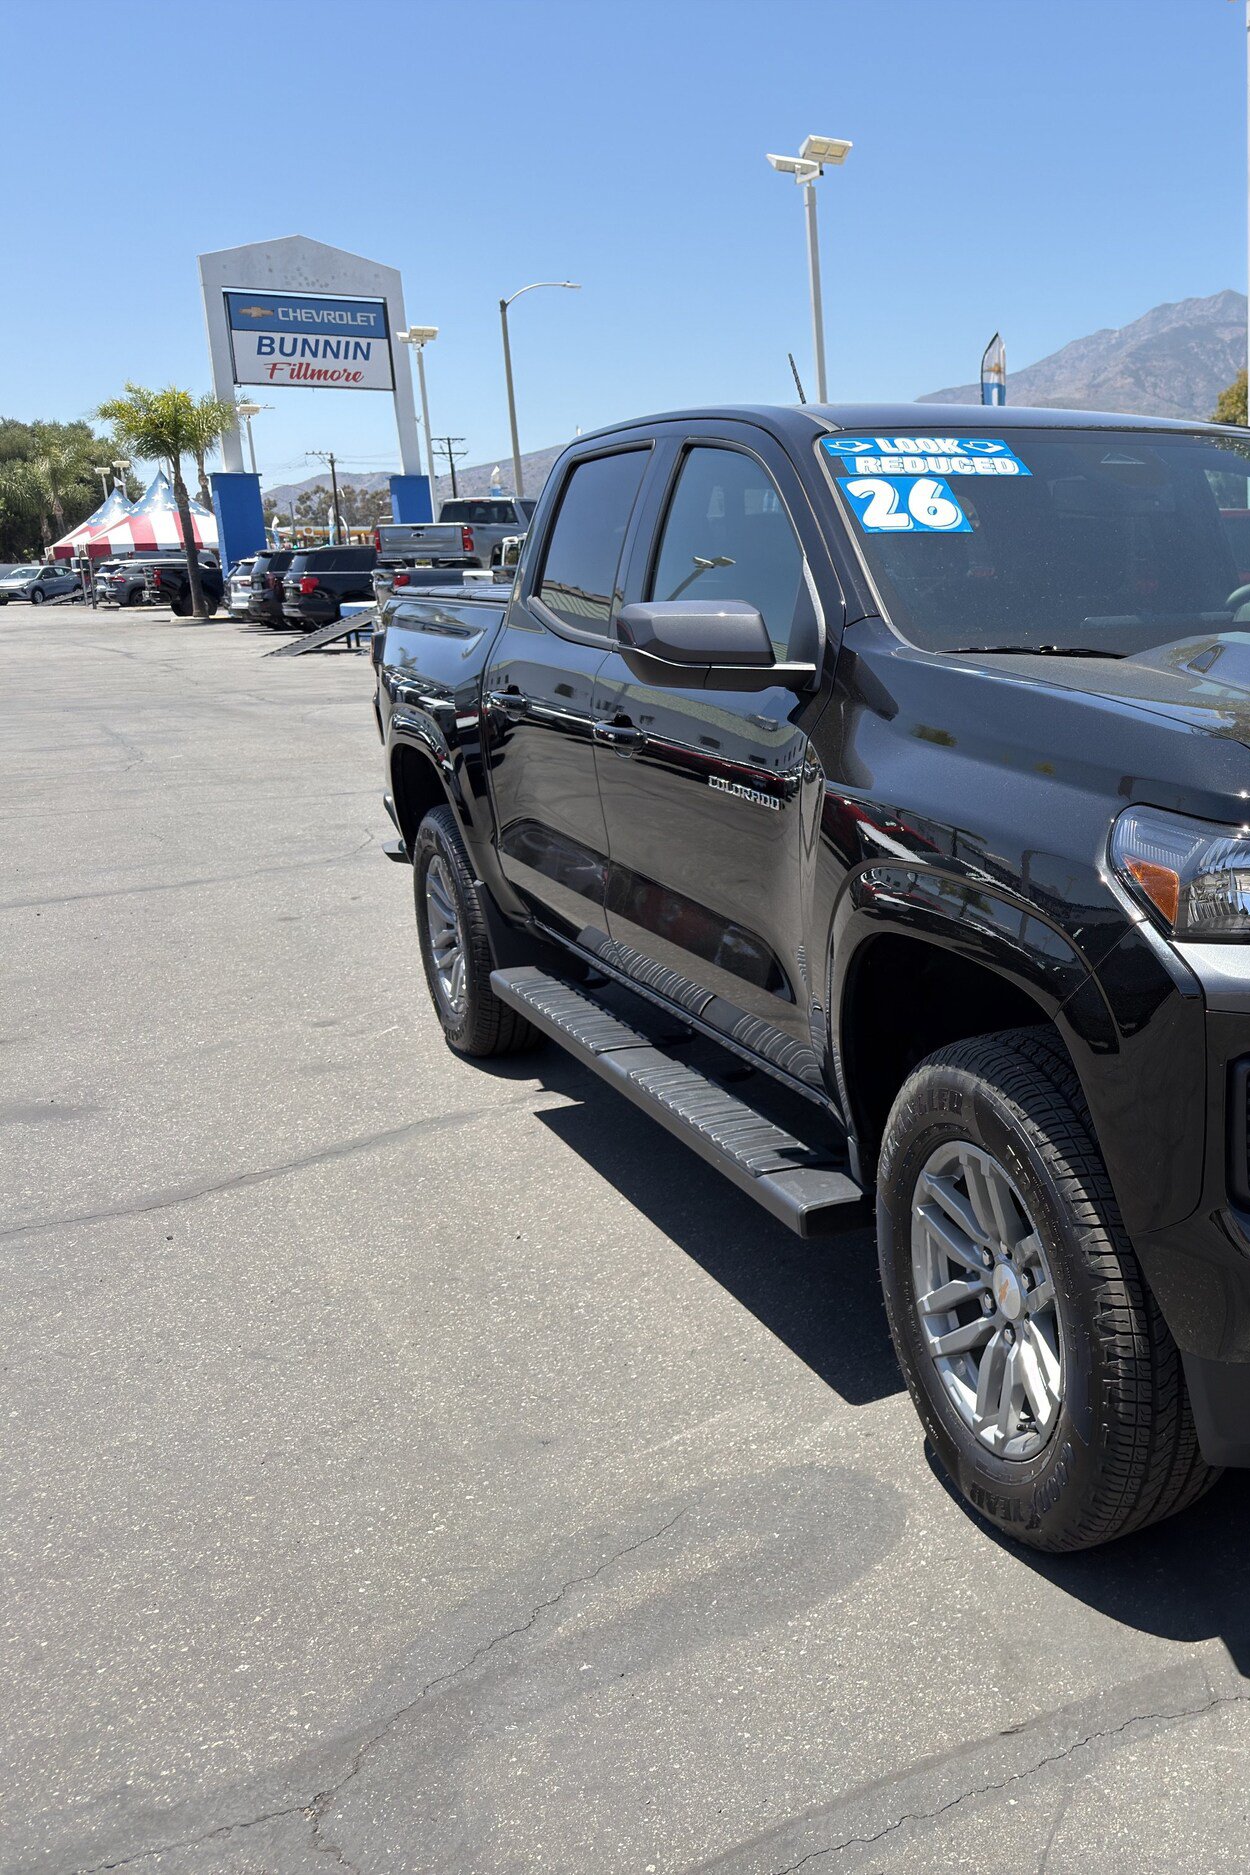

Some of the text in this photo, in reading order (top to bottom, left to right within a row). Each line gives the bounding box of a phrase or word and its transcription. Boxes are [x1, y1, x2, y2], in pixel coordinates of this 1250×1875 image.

[278, 307, 377, 326] CHEVROLET
[256, 335, 372, 361] BUNNIN
[263, 362, 364, 383] Fillmore
[874, 437, 968, 454] LOOK
[855, 457, 1020, 475] REDUCED
[846, 478, 963, 530] 26
[708, 775, 780, 811] COLORADO
